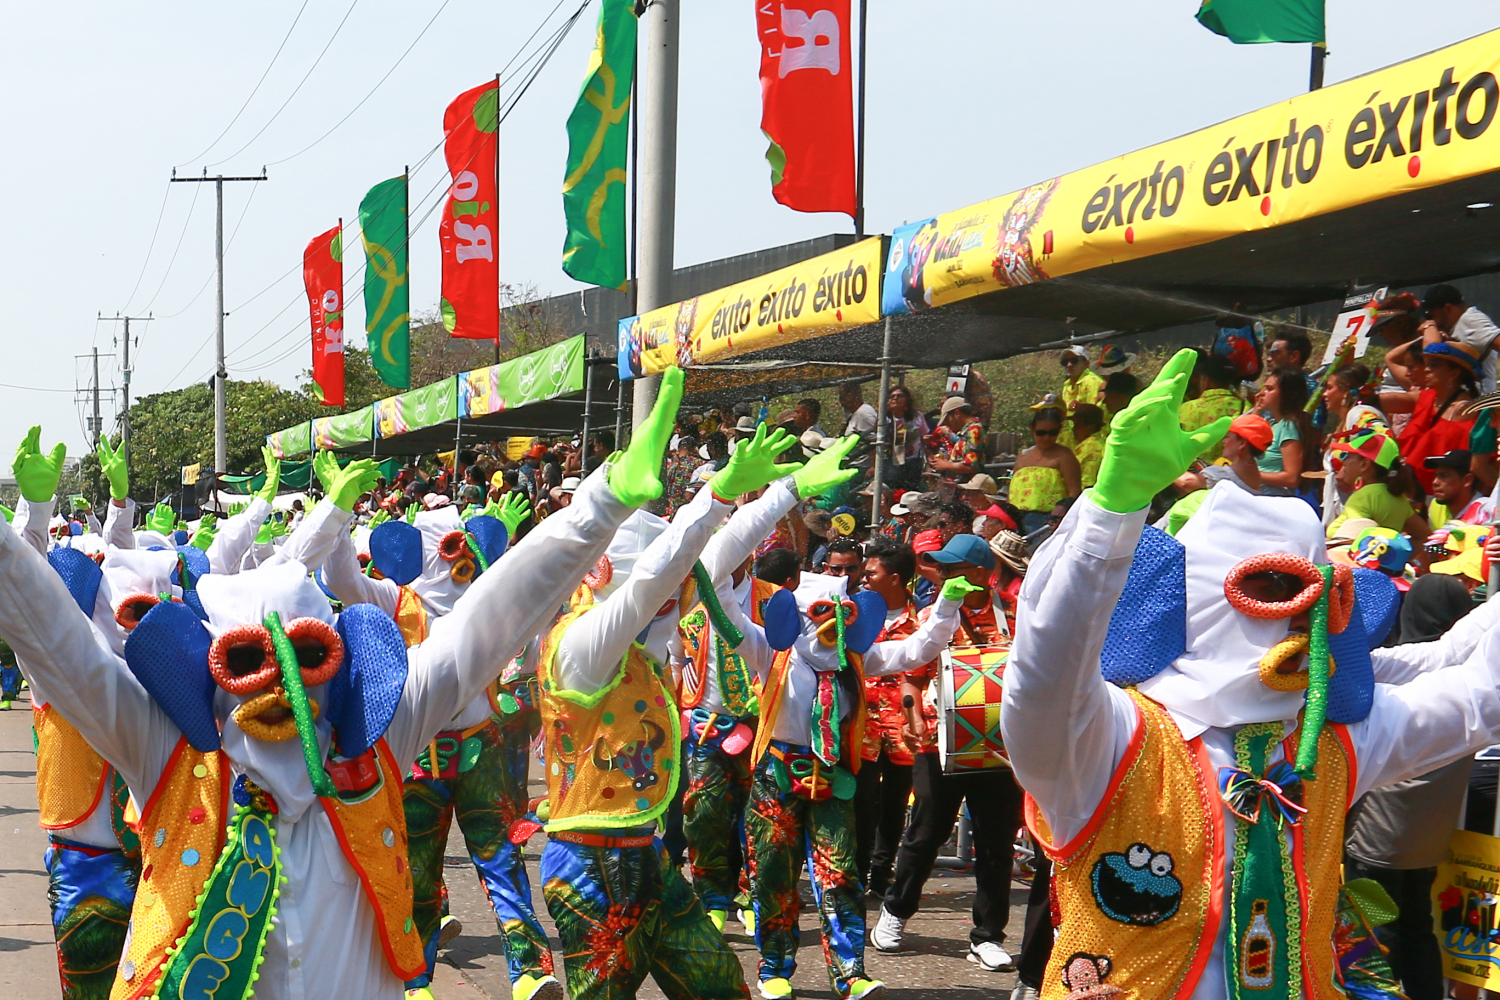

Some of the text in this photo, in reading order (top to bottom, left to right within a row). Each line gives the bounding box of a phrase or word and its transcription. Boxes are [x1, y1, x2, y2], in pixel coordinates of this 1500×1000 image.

[1082, 66, 1499, 244] éxito éxito éxito
[757, 277, 807, 334] éxito
[813, 260, 867, 322] éxito
